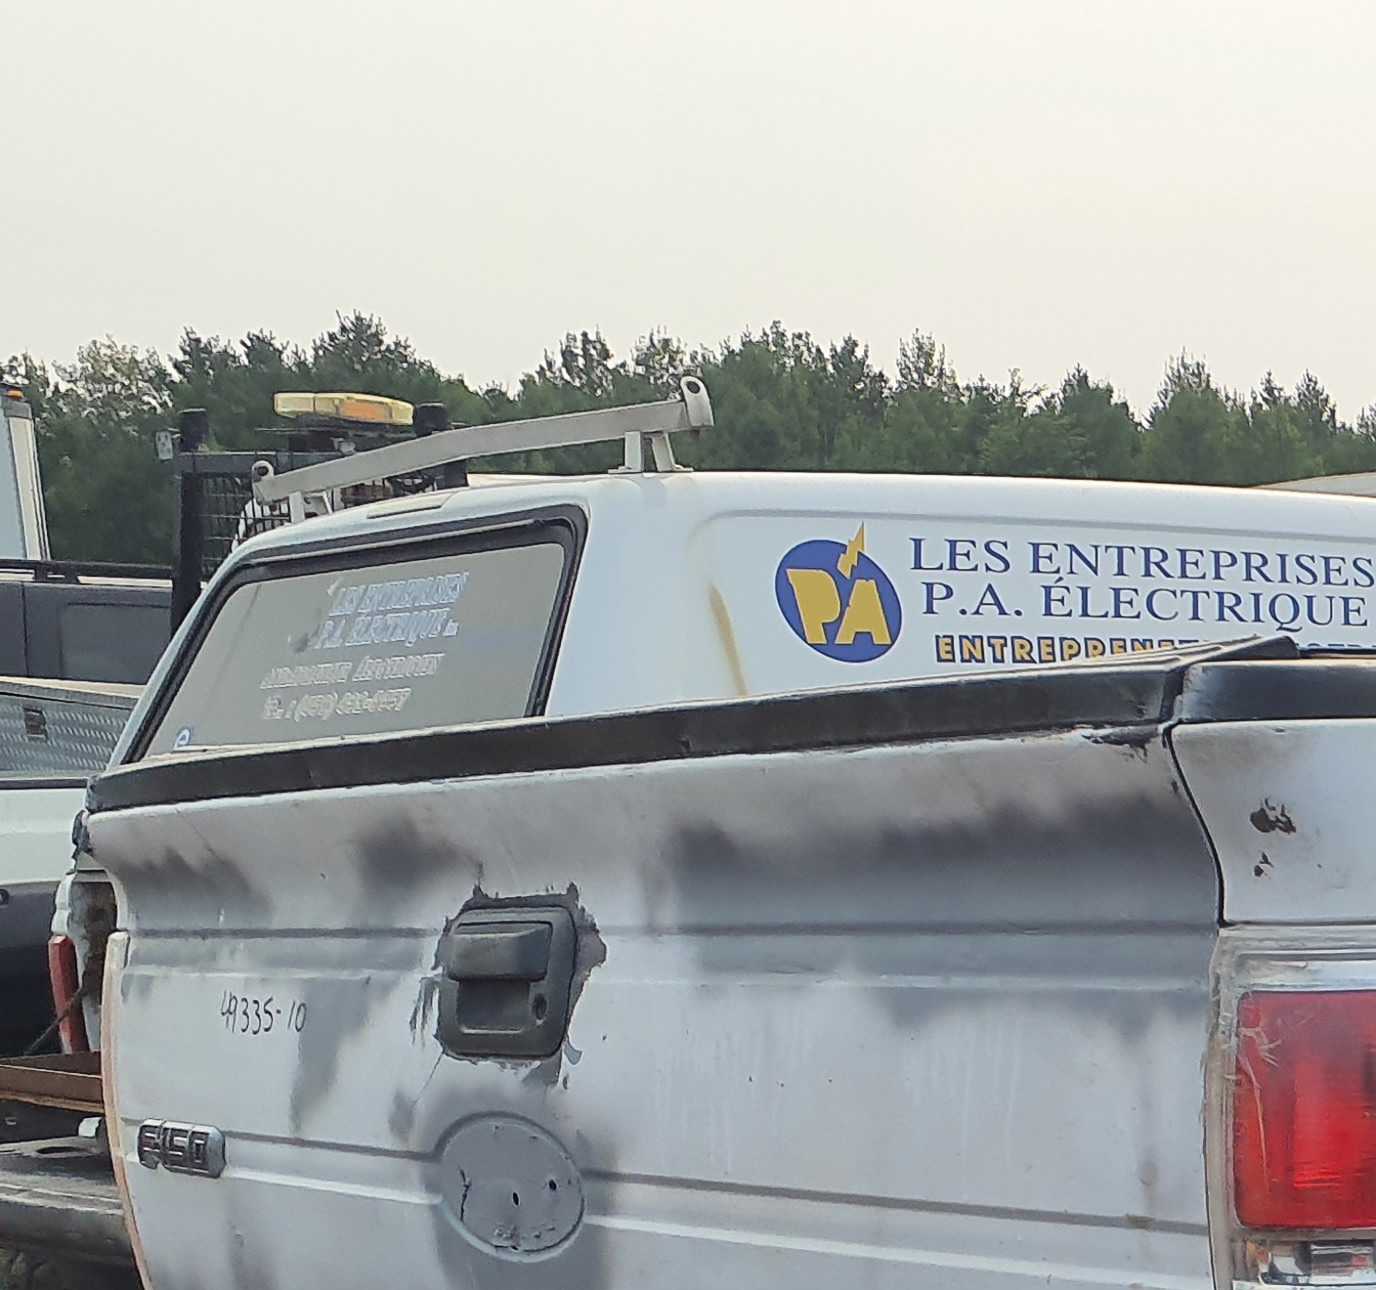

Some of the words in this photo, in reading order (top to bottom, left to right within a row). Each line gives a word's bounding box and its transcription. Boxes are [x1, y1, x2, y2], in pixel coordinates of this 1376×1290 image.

[909, 537, 1011, 575] LES
[1028, 541, 1376, 589] ENTREPRISES
[921, 581, 1024, 617] P.A.
[1041, 577, 1369, 633] ÉLECTRIQUE
